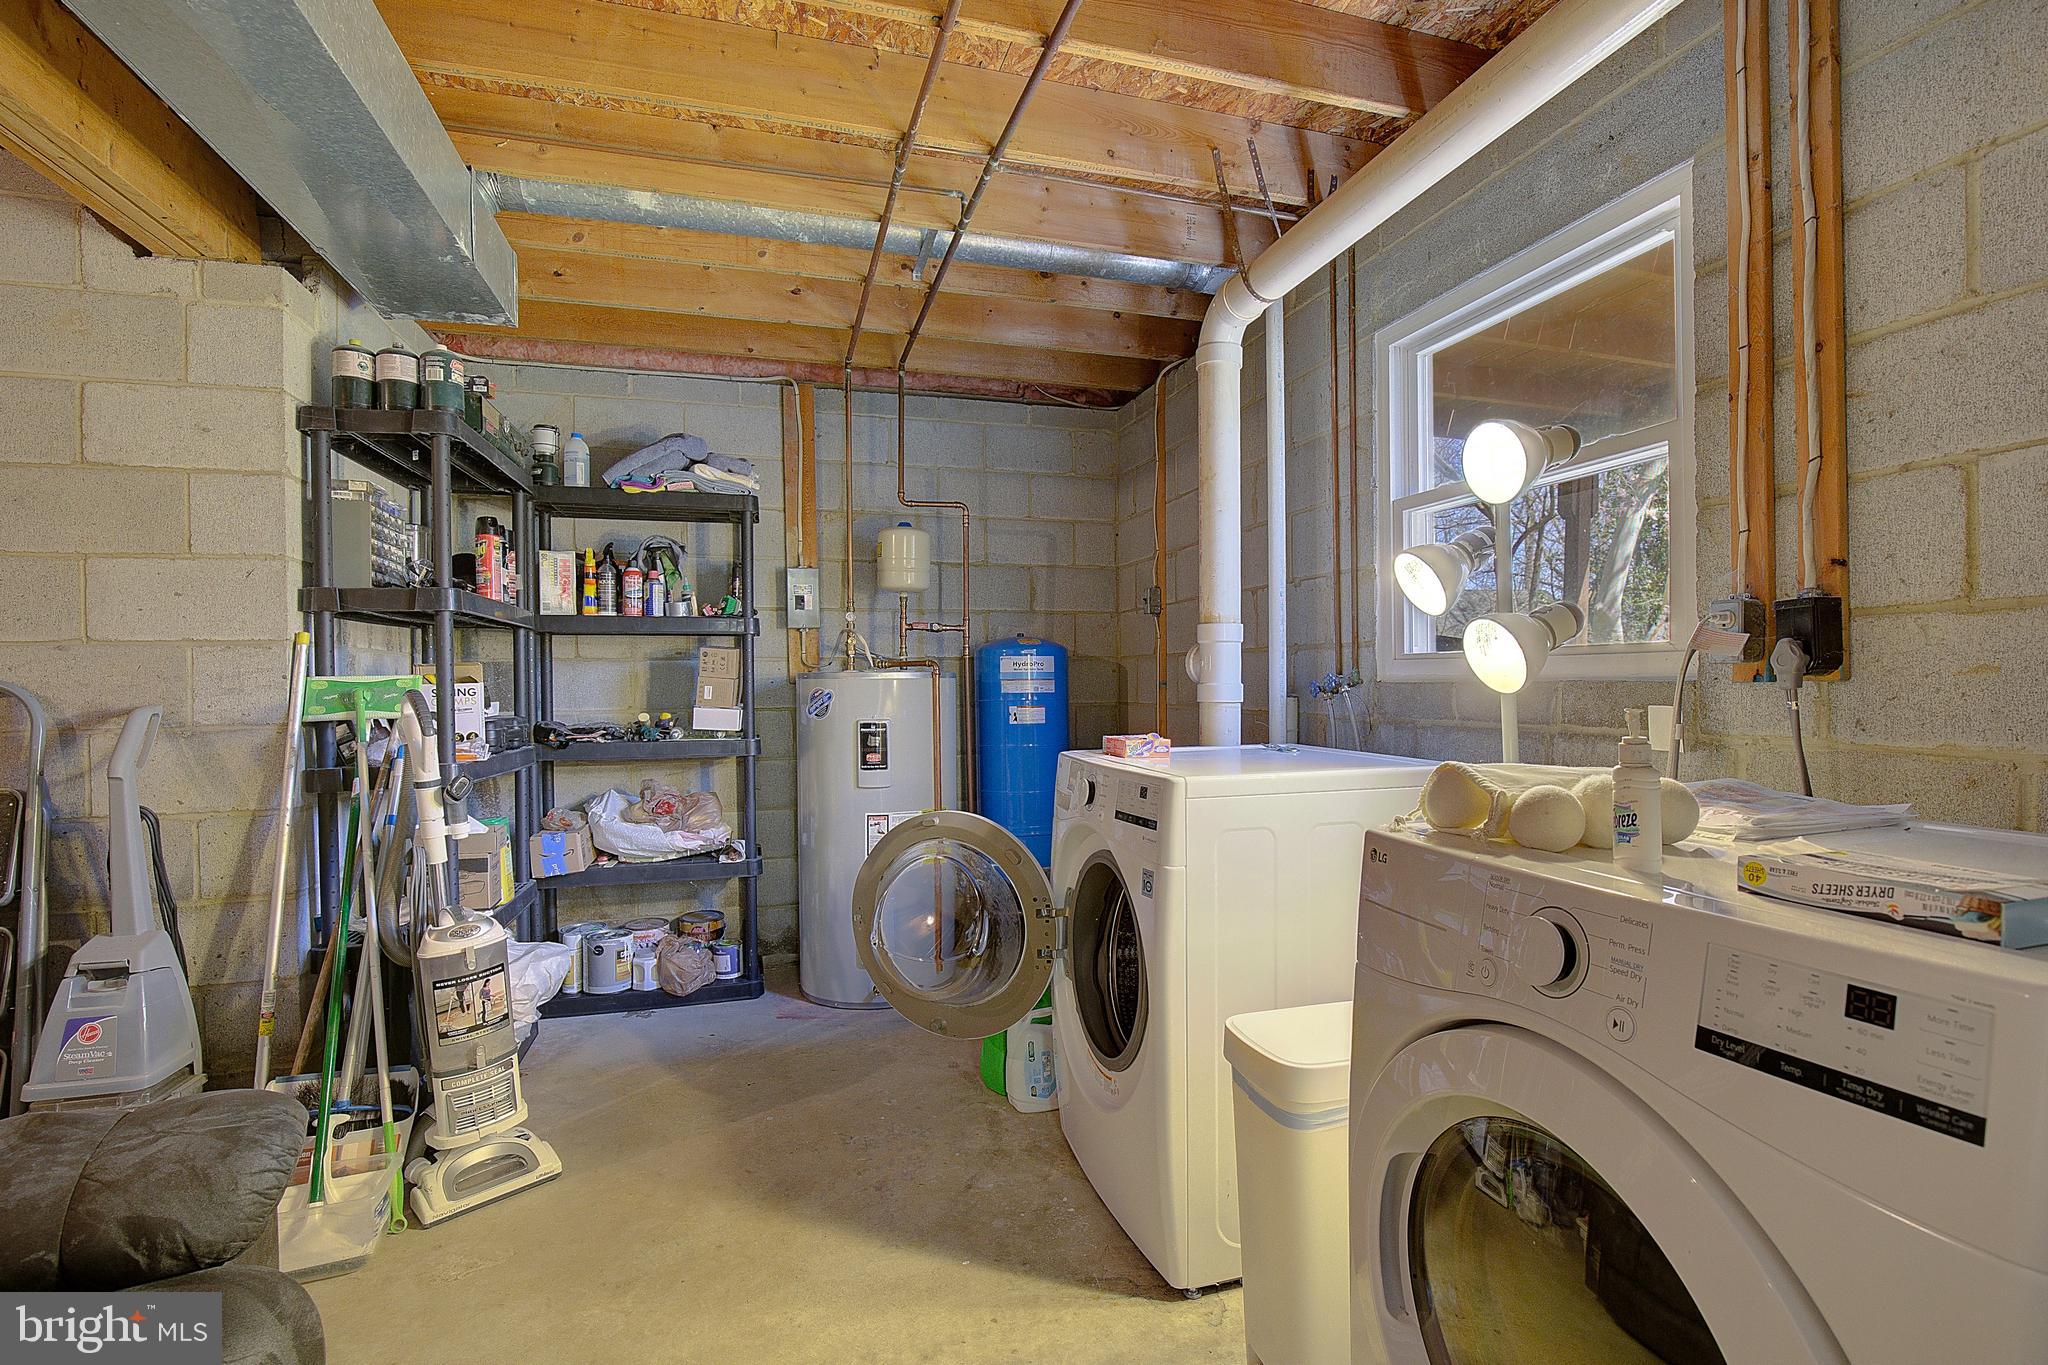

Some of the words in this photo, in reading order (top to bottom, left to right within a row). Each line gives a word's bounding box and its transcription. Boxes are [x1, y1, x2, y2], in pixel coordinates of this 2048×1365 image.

[1747, 872, 1762, 883] 40
[1811, 882, 1854, 898] SHEETS
[1856, 883, 1895, 899] DRYER
[1619, 915, 1649, 930] Delicates
[1608, 938, 1626, 951] Perm.
[1628, 943, 1646, 955] Press
[1609, 965, 1629, 978] Speed
[1629, 971, 1643, 983] Dry
[435, 979, 457, 988] NEVER
[1615, 993, 1625, 1003] Air
[1626, 996, 1639, 1009] Dry
[1927, 1013, 1950, 1027] More
[1954, 1020, 1976, 1033] Time
[1711, 1034, 1725, 1048] Dry
[1725, 1039, 1746, 1053] Level
[63, 1050, 106, 1061] SteamVac
[1925, 1047, 1946, 1060] Less
[1948, 1052, 1971, 1066] Time
[451, 1072, 489, 1088] COMPLETE
[490, 1065, 506, 1076] SEAL
[1780, 1060, 1804, 1078] Temp.
[1841, 1077, 1865, 1094] Time
[1865, 1083, 1885, 1101] Dry
[1916, 1074, 1947, 1091] Energy
[1916, 1103, 1950, 1123] Wrinkle
[1951, 1113, 1975, 1131] Care
[432, 1202, 472, 1220] Navigator
